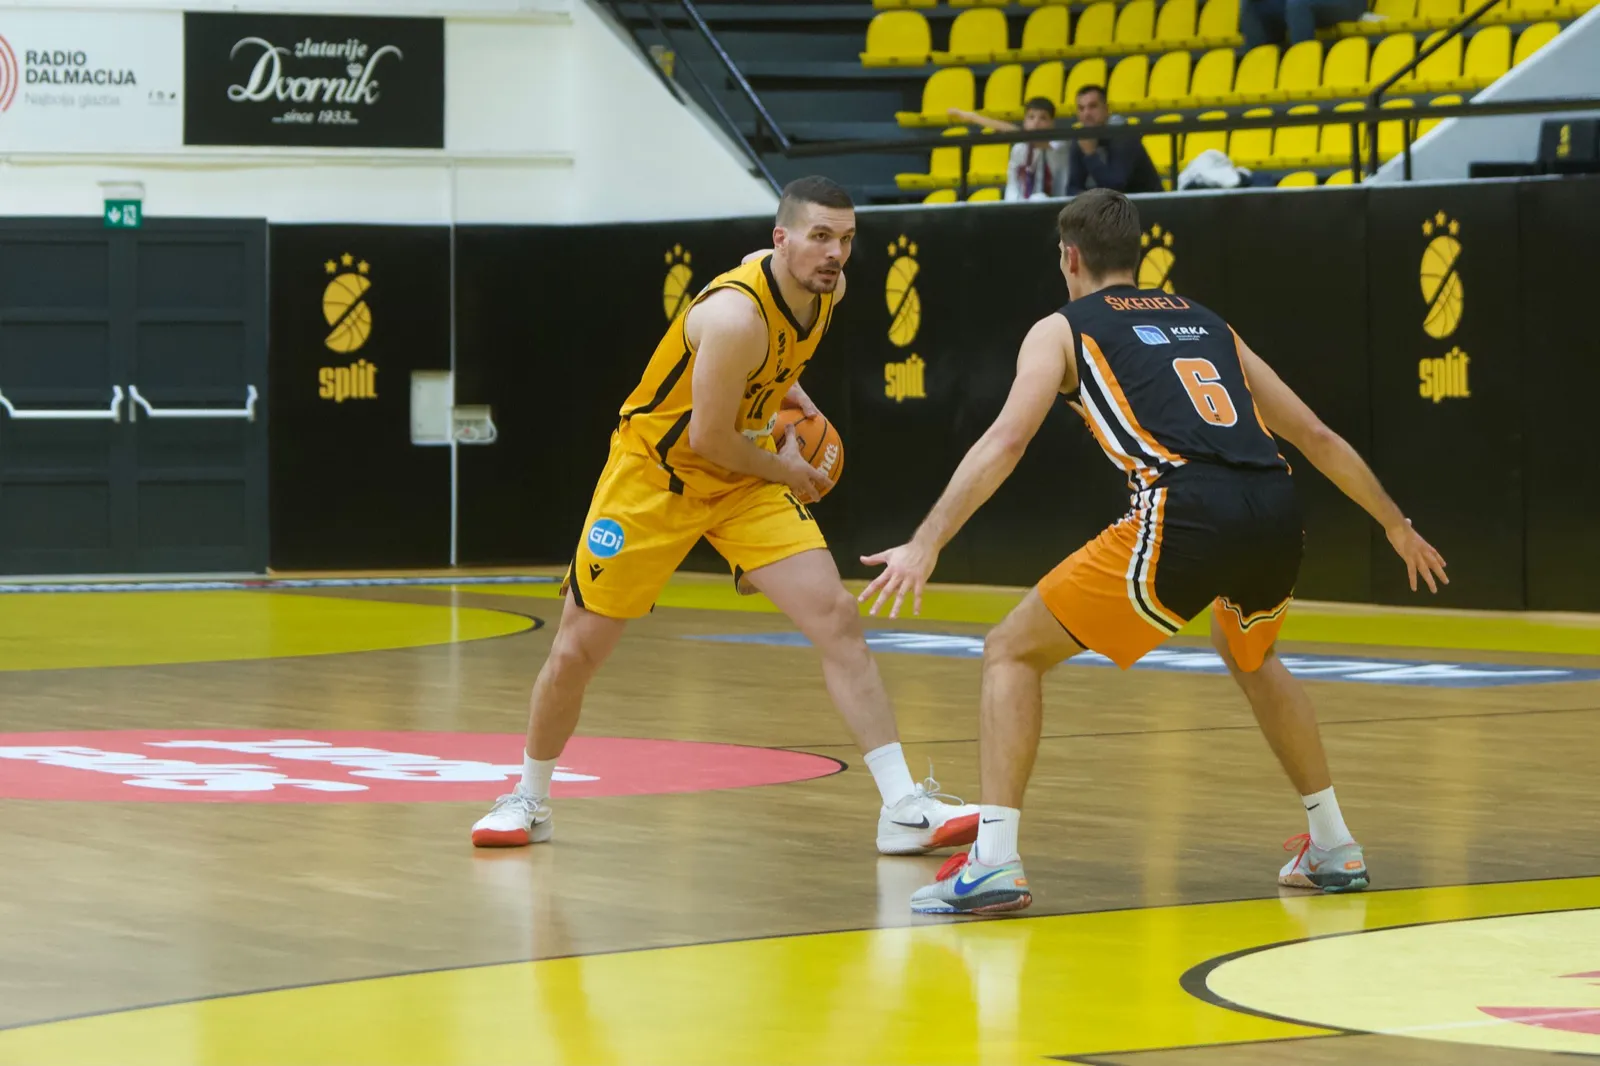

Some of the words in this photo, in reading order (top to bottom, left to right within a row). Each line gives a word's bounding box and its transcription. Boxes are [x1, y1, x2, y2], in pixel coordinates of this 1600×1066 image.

[25, 50, 87, 66] RADIO
[294, 37, 368, 60] zlatarije
[25, 69, 137, 85] DALMACIJA
[227, 36, 403, 104] Dvornik
[1169, 326, 1209, 336] KRKA
[318, 358, 378, 403] split
[884, 352, 927, 403] split
[1418, 345, 1471, 403] split
[1172, 357, 1238, 427] 6
[589, 526, 623, 550] GDi
